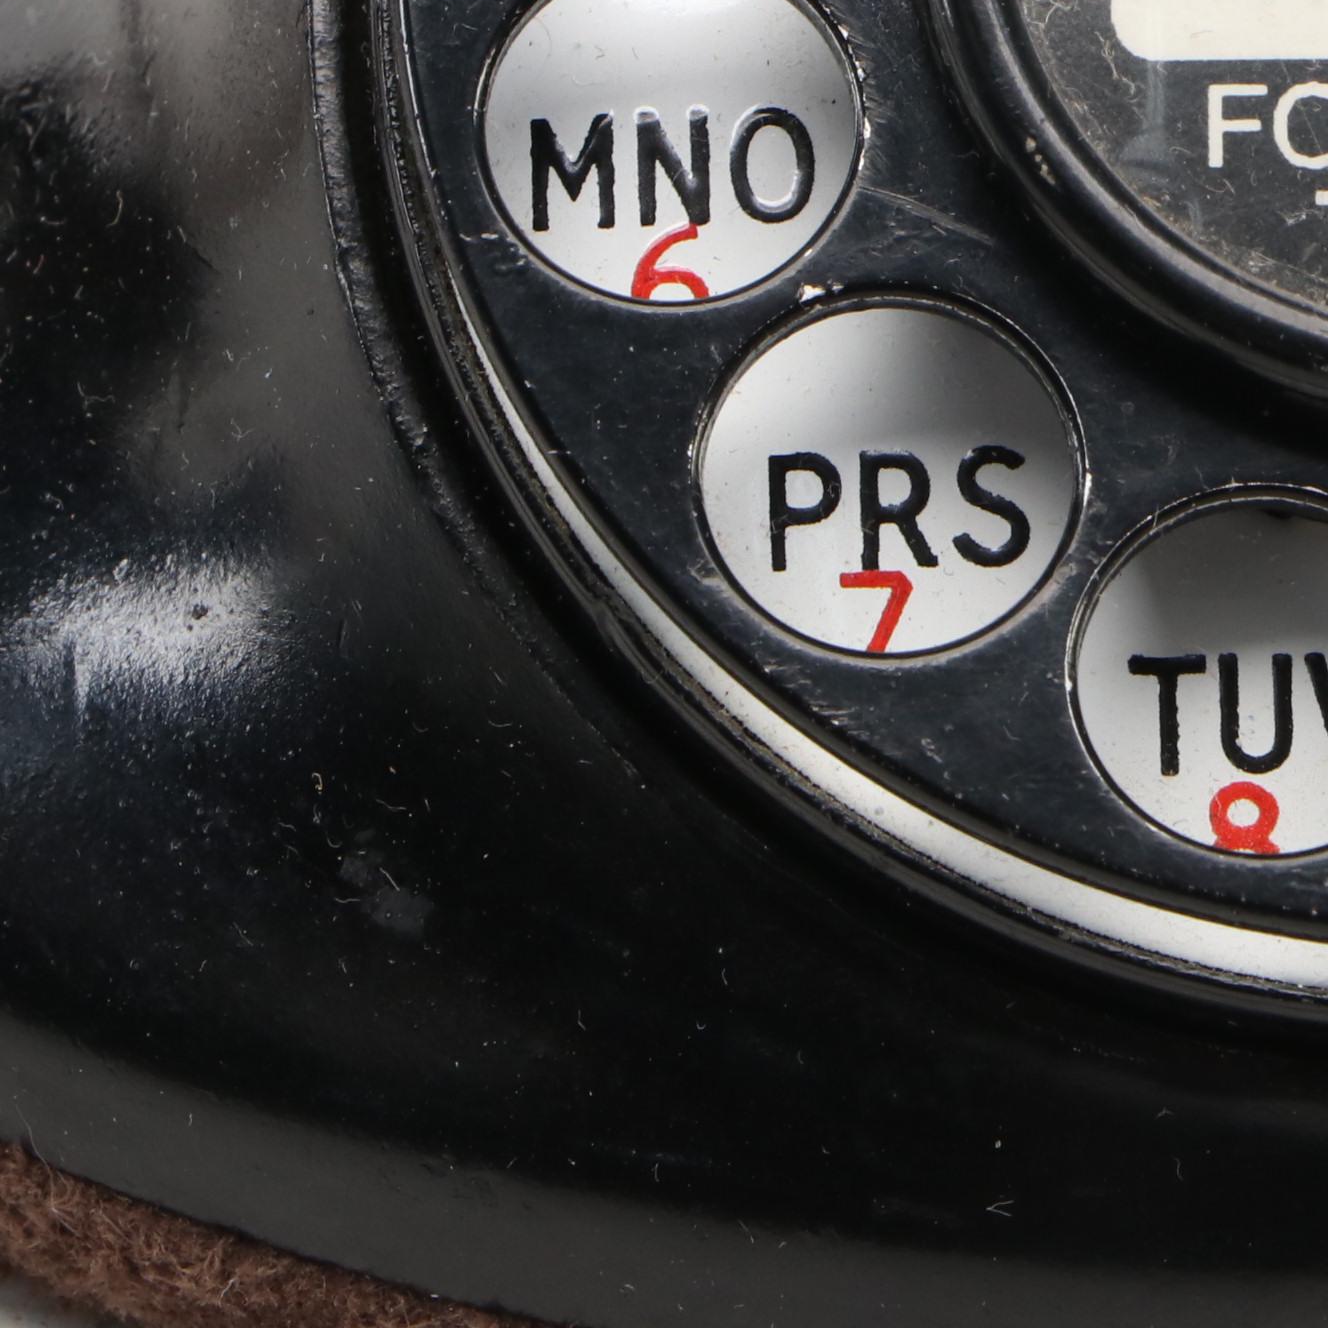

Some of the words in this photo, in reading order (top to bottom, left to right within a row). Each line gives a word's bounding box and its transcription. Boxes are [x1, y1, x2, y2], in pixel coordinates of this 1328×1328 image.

[530, 108, 815, 232] MNO
[768, 444, 1032, 573] PRS
[838, 569, 914, 654] 7
